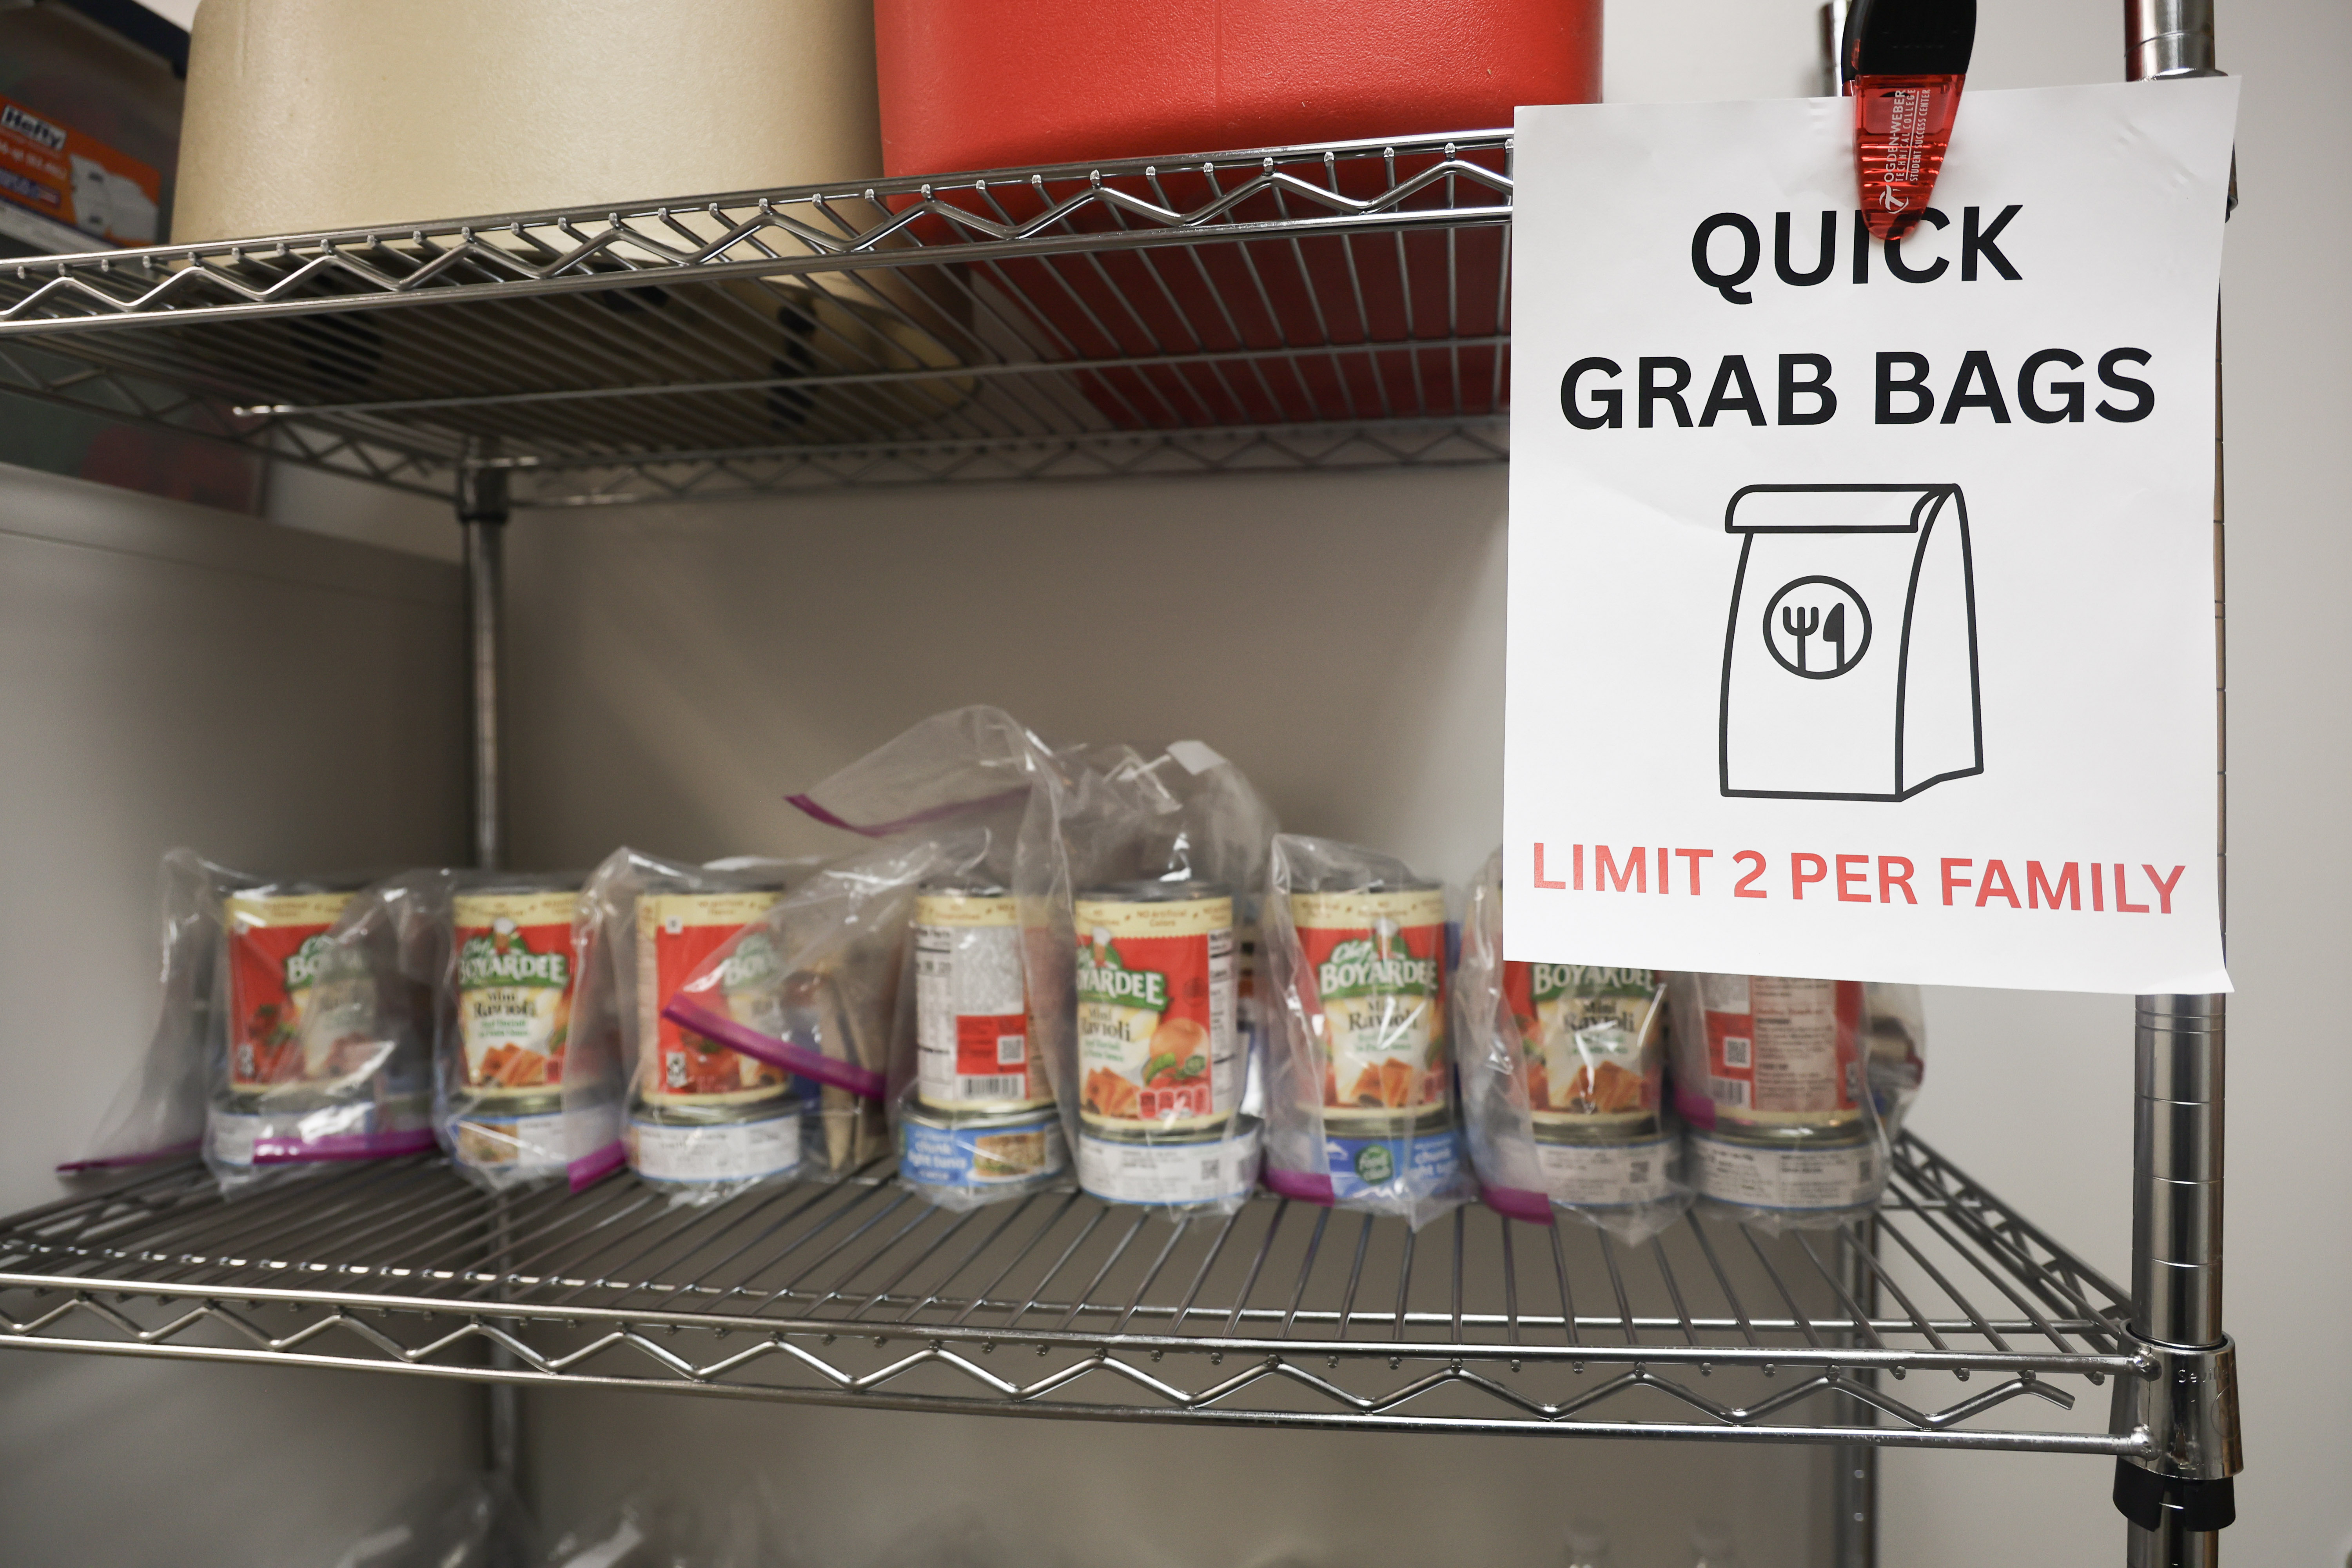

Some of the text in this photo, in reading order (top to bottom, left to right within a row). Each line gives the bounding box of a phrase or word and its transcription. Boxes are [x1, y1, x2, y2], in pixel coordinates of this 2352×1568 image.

[5, 110, 60, 147] Hefty
[1884, 90, 1906, 182] OGDEN-WEBER
[1895, 89, 1916, 182] TECHNICAL COLLEGE
[1910, 89, 1931, 181] STUDENT SUCCESS CENTER
[1691, 205, 2023, 305] QUICK
[1561, 347, 2155, 430] GRAB BAGS
[1534, 842, 2186, 914] LIMIT 2 PER FAMILY
[1077, 966, 1164, 1005] YARDEE
